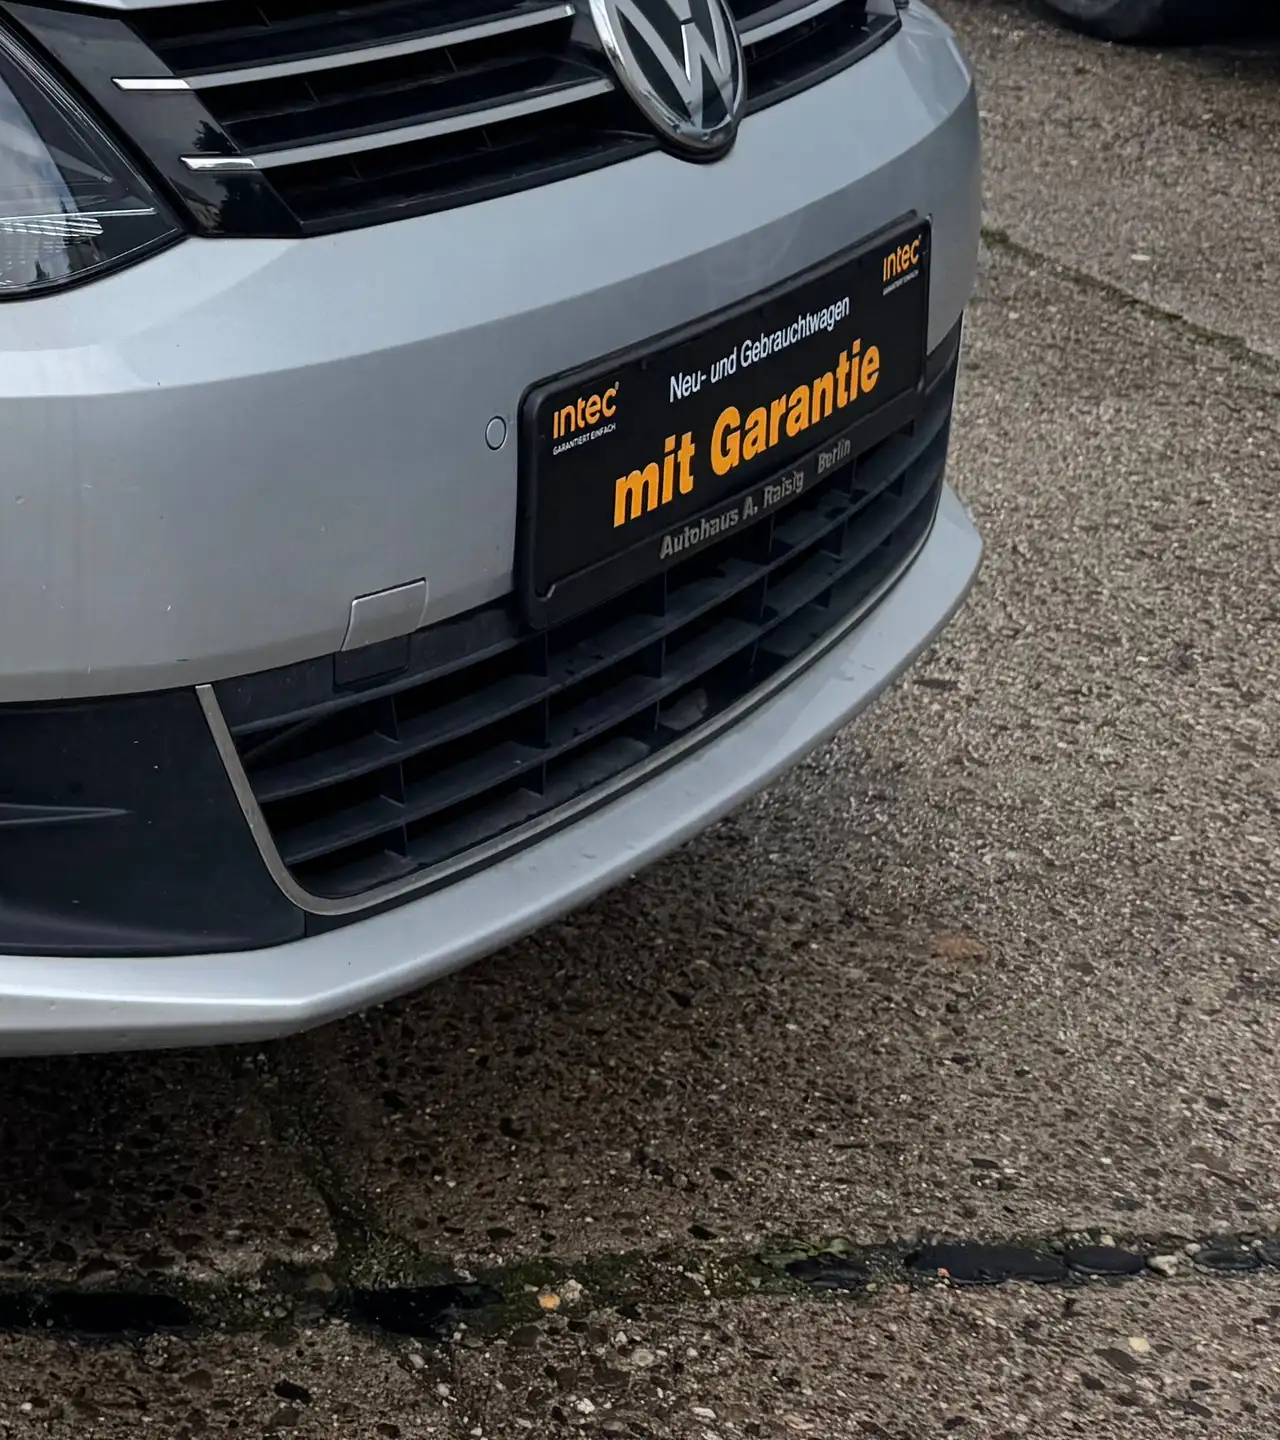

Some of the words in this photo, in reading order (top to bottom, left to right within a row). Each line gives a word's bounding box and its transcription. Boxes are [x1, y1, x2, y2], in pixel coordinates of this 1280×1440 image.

[670, 371, 707, 403] Neu-
[710, 345, 737, 383] und
[740, 295, 850, 369] Gebrauchtwagen
[613, 431, 695, 529] mit
[710, 338, 881, 477] Garantie
[659, 508, 739, 560] Autohaus
[763, 469, 804, 509] Raisig
[817, 438, 851, 475] Berlin
